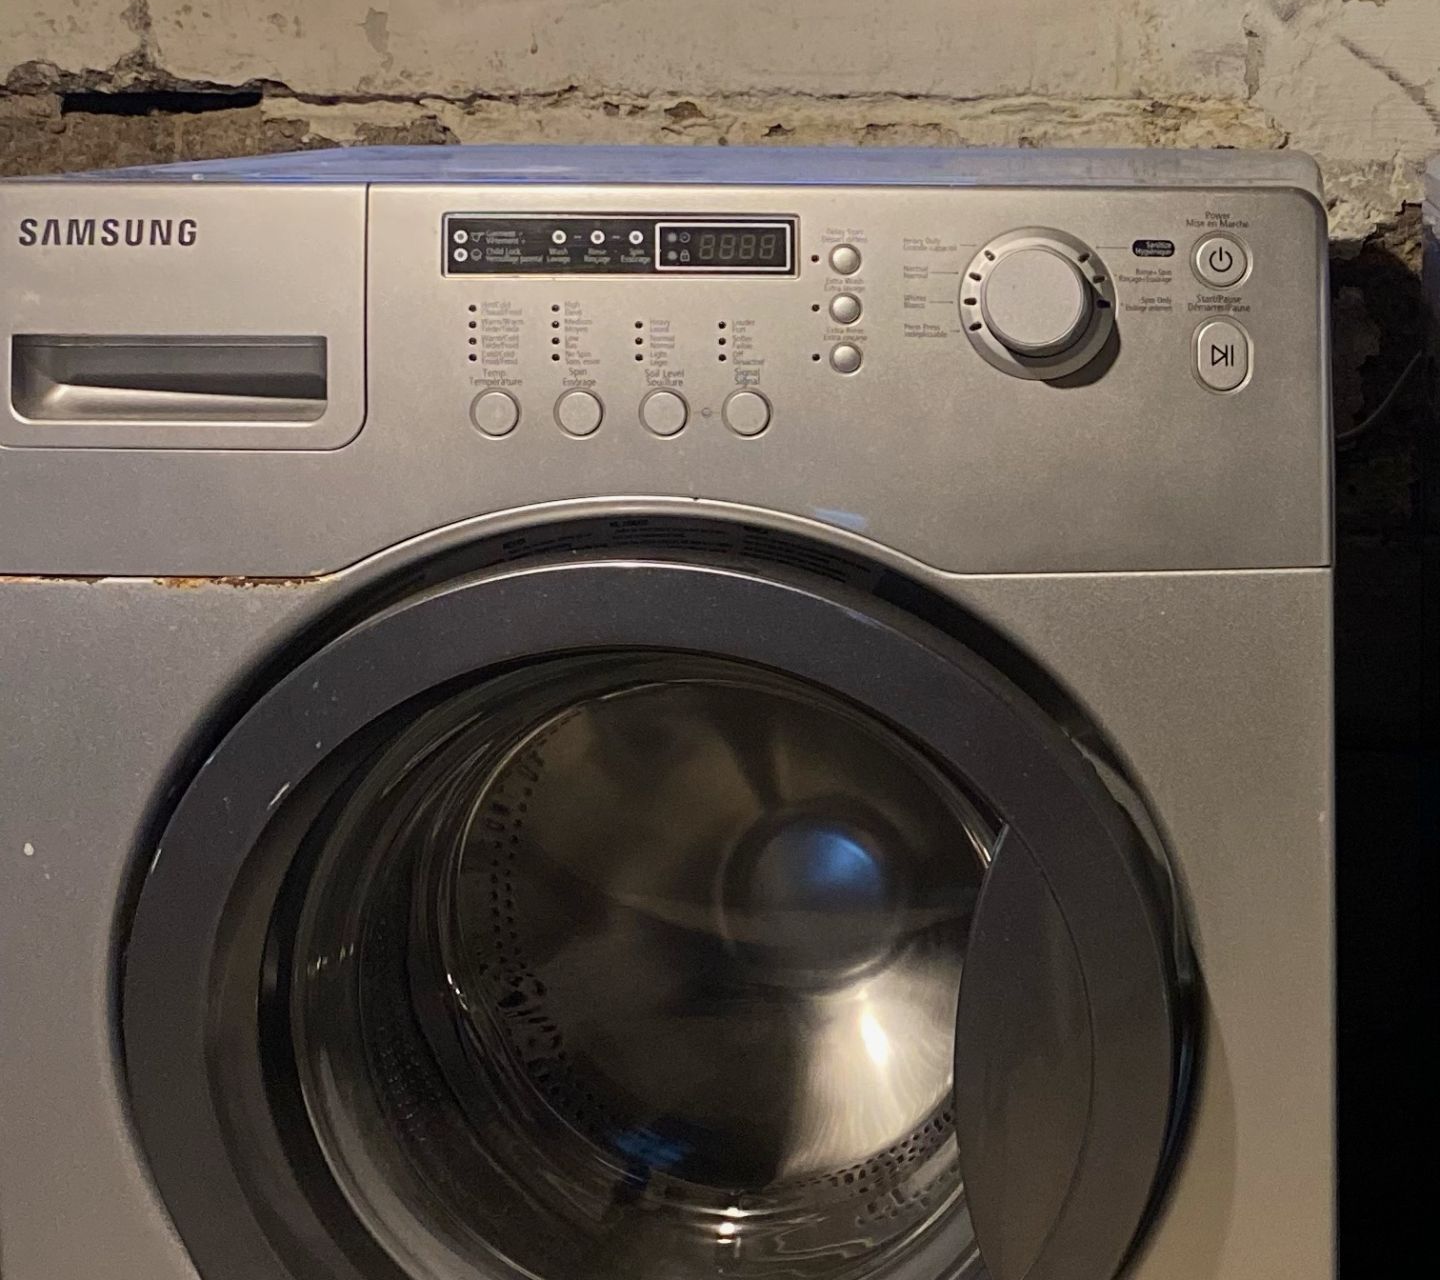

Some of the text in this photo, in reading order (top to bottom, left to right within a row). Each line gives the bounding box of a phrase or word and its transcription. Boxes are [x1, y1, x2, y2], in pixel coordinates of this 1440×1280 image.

[1205, 211, 1231, 220] Power
[18, 218, 197, 246] SAMSUNG
[645, 369, 685, 378] Soil Level
